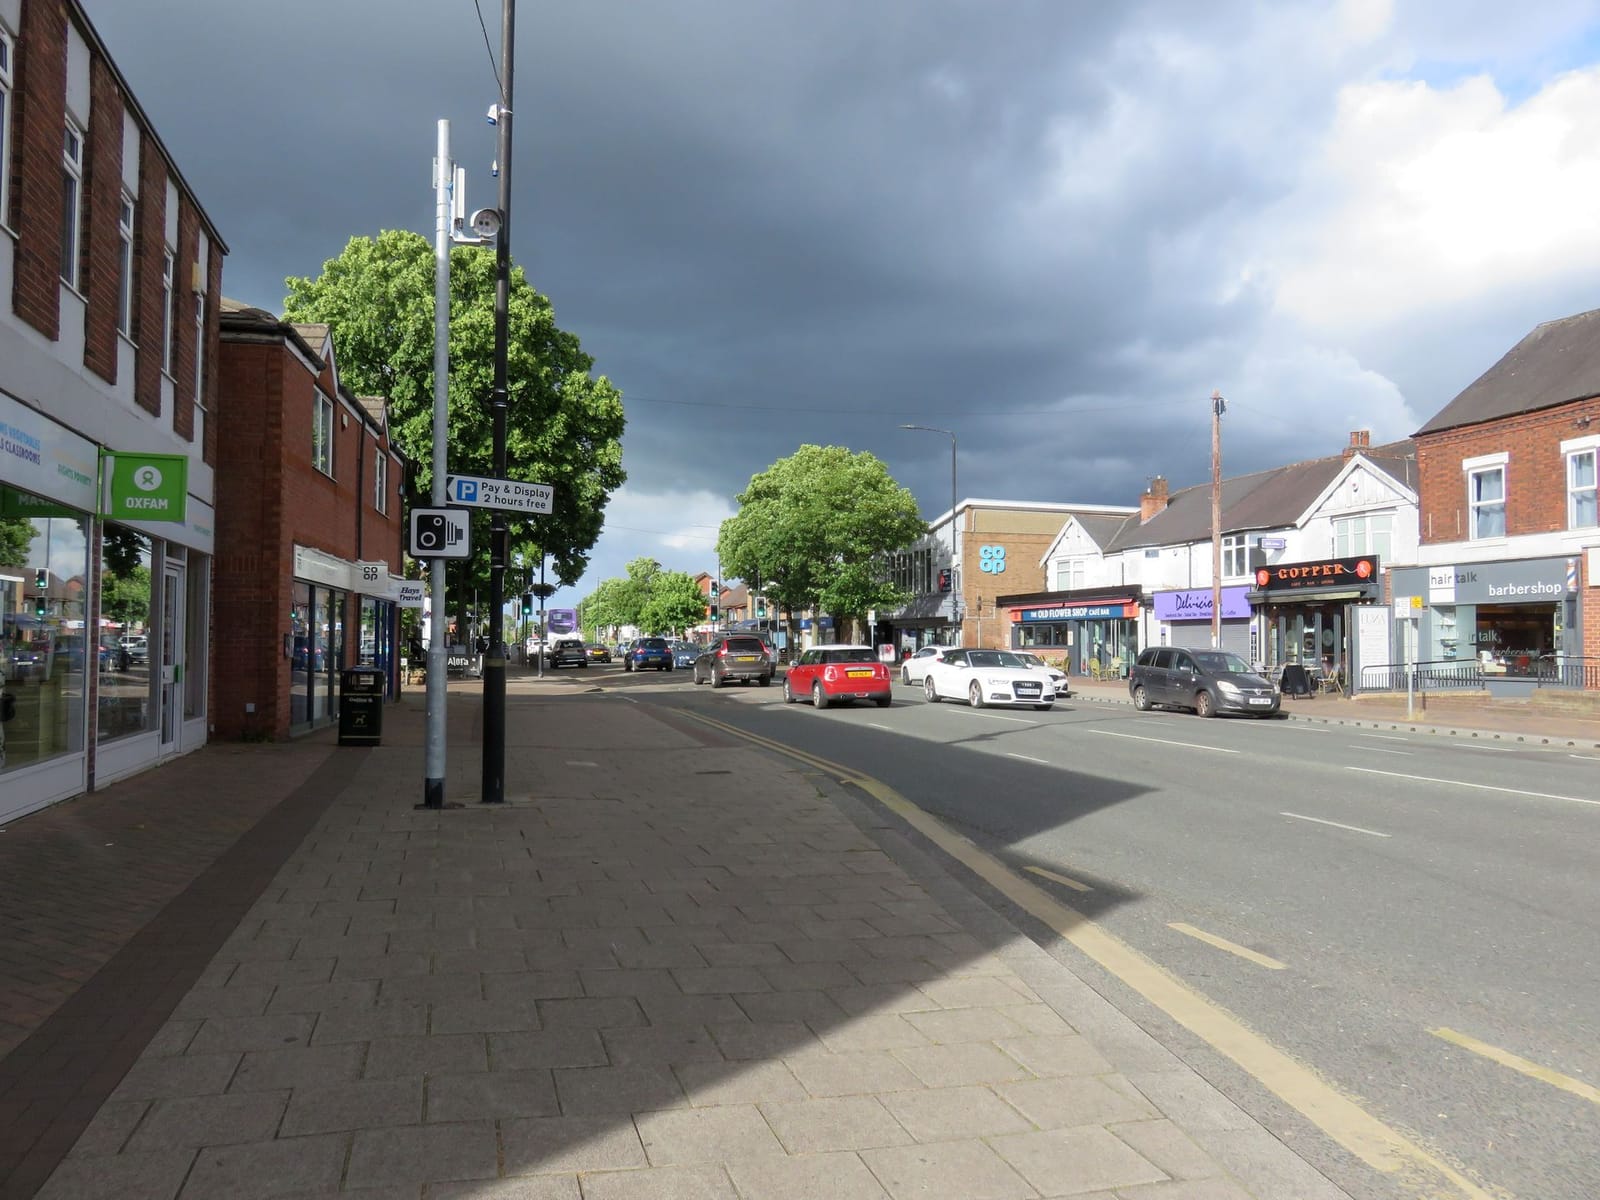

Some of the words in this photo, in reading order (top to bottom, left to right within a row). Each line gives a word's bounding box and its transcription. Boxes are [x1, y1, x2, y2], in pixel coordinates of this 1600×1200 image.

[5, 440, 41, 466] CLASSROOMS
[461, 482, 476, 499] P
[481, 482, 500, 494] Pay
[503, 484, 510, 494] &
[514, 486, 550, 500] Display
[126, 496, 168, 510] OXFAM
[483, 493, 491, 503] 2
[494, 495, 523, 507] hours
[526, 499, 546, 509] free
[1278, 563, 1344, 580] COPPER
[1430, 573, 1452, 585] hair
[1455, 571, 1478, 584] talk
[401, 586, 420, 595] Hays
[1488, 581, 1562, 597] barbershop
[400, 594, 423, 602] Travel
[1037, 608, 1049, 618] OLD
[1049, 608, 1071, 618] FLOWER
[1071, 607, 1088, 617] SHOP
[1100, 608, 1110, 616] BAR
[1479, 629, 1498, 642] talk
[447, 656, 469, 667] Alora
